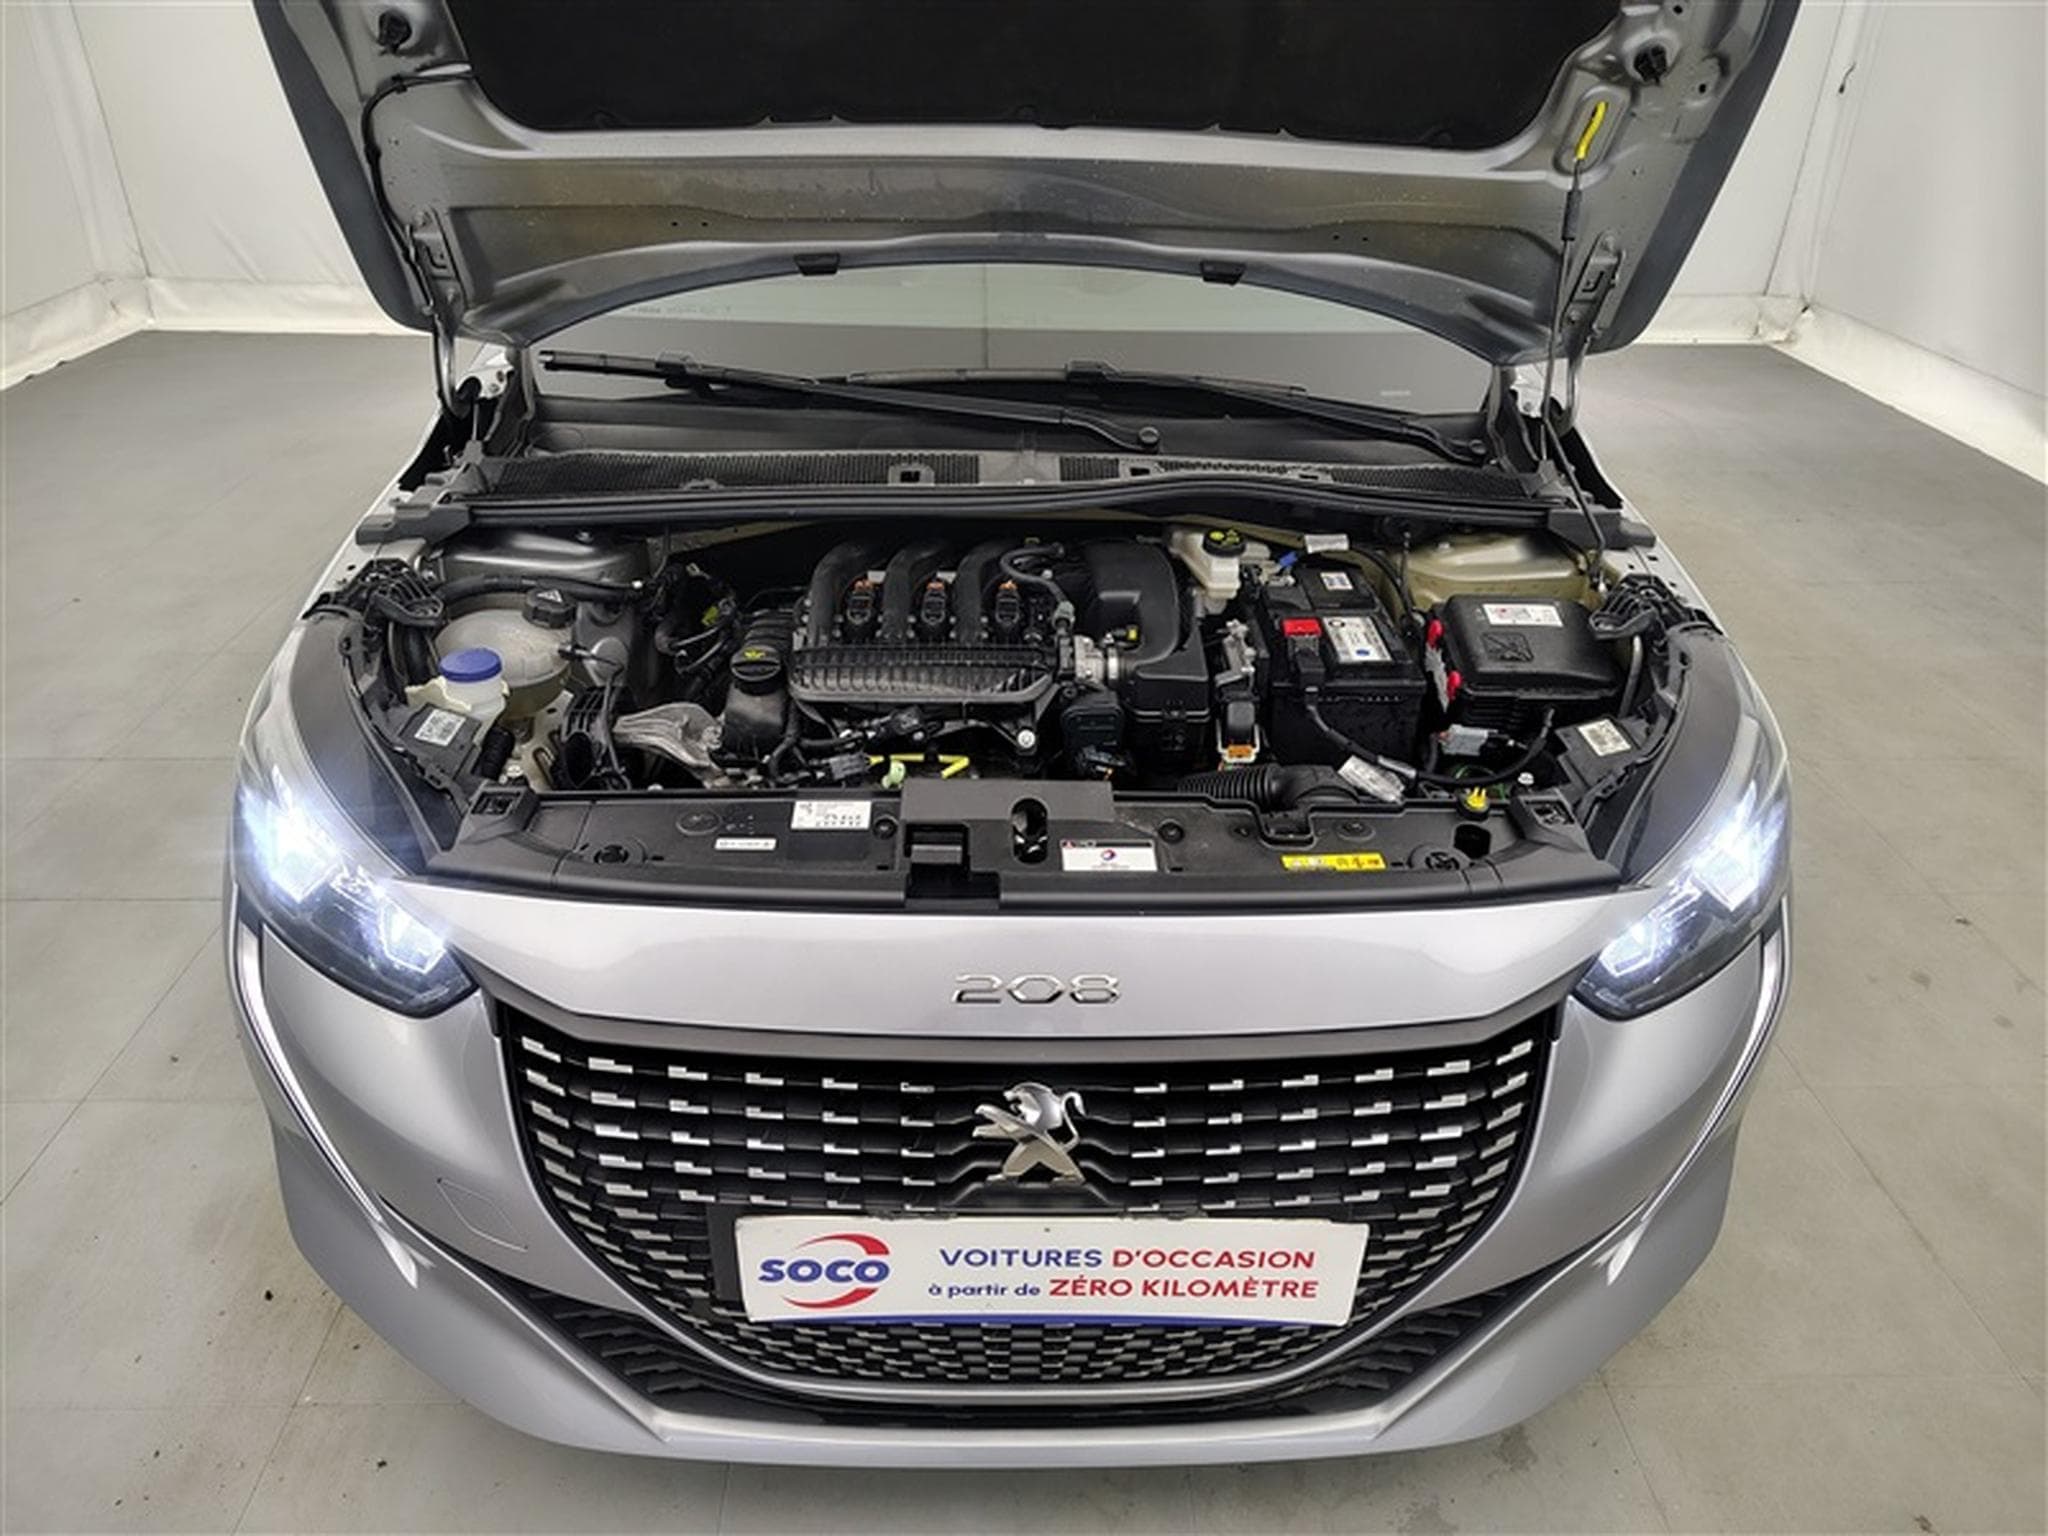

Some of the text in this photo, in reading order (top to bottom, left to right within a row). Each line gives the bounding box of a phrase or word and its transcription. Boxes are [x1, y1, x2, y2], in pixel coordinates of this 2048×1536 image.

[952, 974, 1121, 1004] 208
[758, 1259, 890, 1283] SOCO
[939, 1248, 1315, 1270] VOITURES D'OCCASION
[928, 1275, 1319, 1300] à partir de ZÉRO KILOMÈTRE
